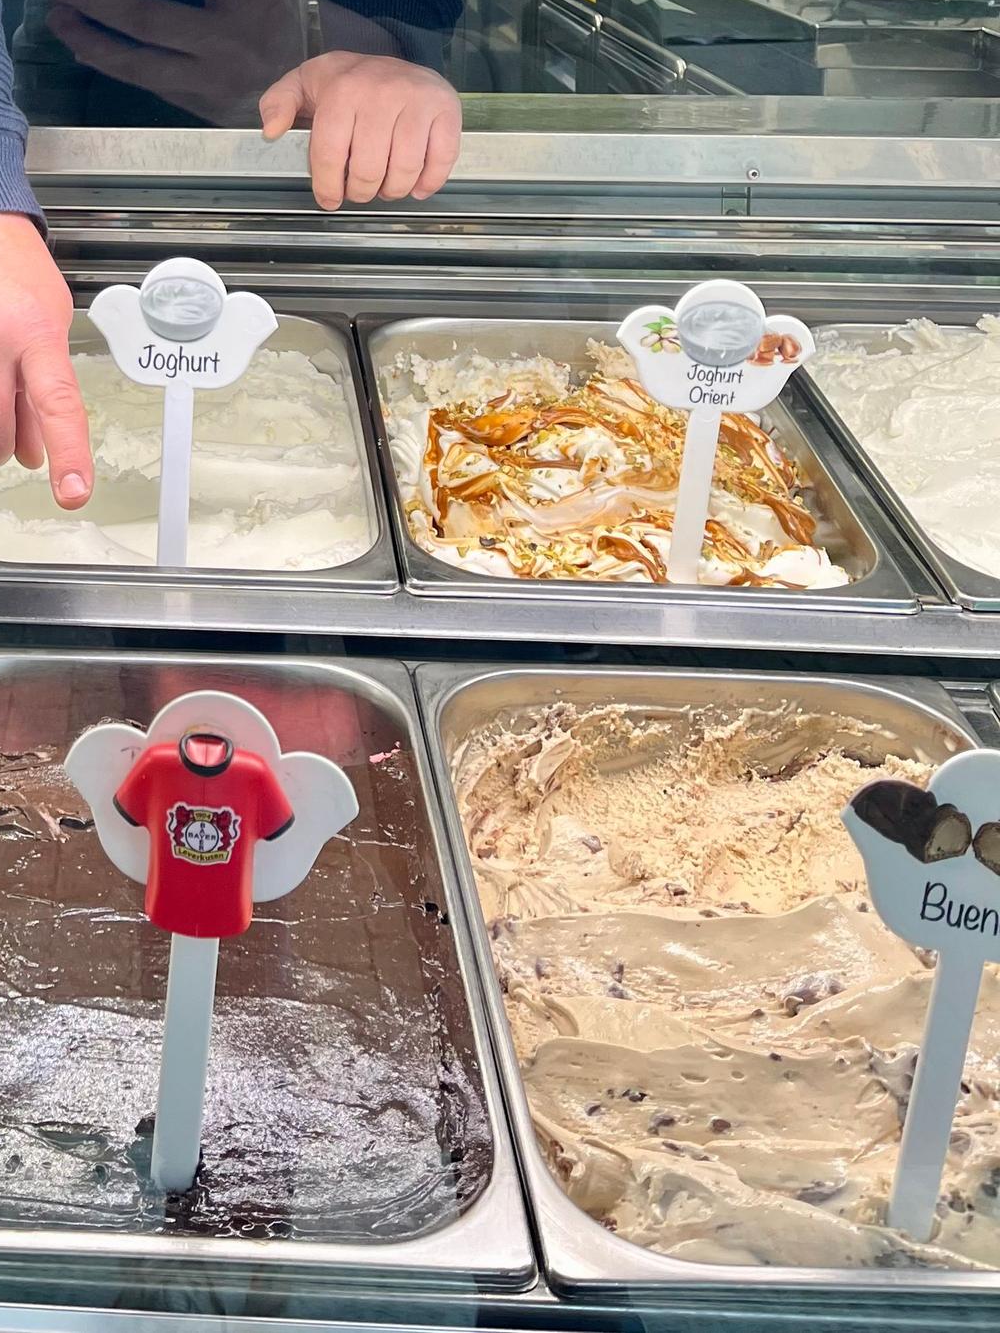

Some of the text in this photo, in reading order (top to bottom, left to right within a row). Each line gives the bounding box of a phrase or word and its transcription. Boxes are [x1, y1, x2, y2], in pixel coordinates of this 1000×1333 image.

[138, 344, 220, 378] Joghurt
[687, 363, 744, 387] Joghurt
[689, 386, 736, 406] Orient
